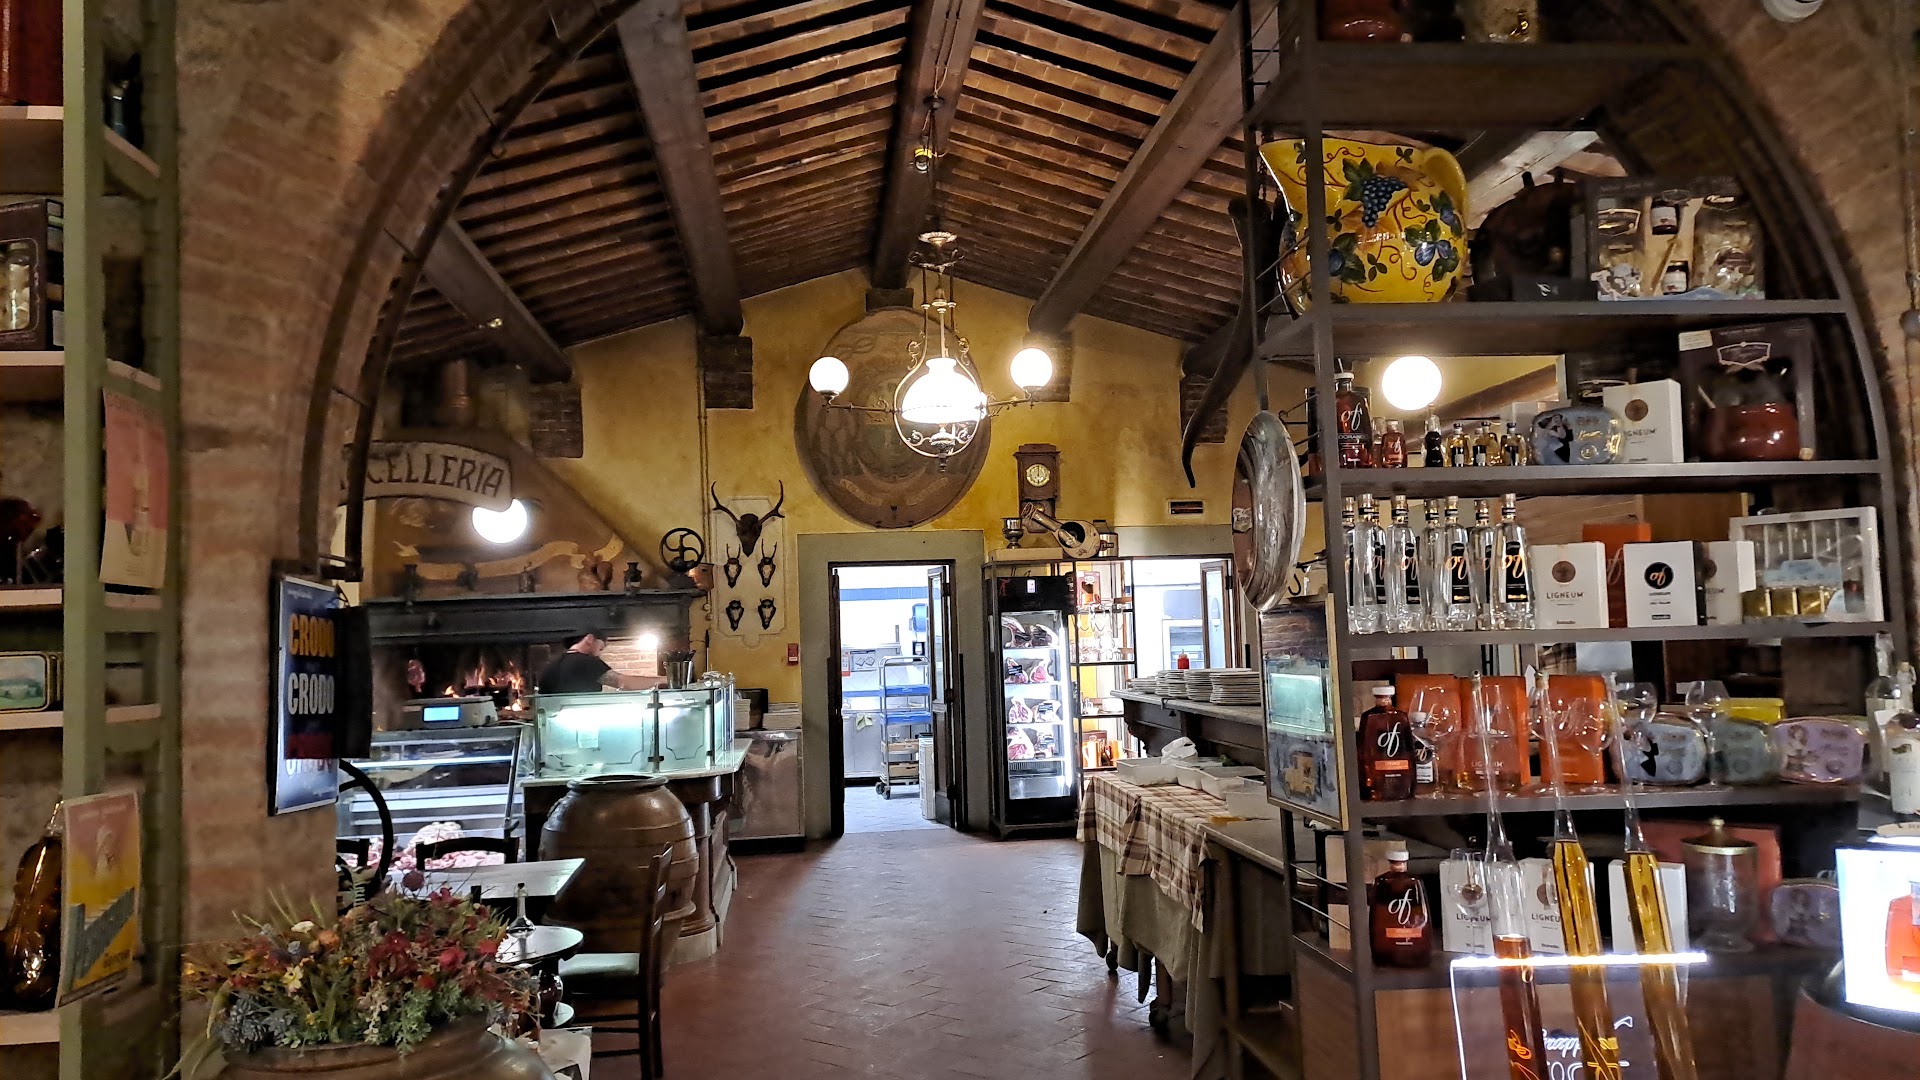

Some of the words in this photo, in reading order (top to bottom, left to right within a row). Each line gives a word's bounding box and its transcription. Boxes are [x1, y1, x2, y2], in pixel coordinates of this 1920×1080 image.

[1623, 428, 1657, 437] IGNEUM
[340, 451, 505, 497] CELLERIA
[1649, 566, 1668, 586] of
[1546, 591, 1585, 599] LIGNEUM
[289, 612, 336, 658] CRODO
[287, 672, 336, 715] CRODO
[1377, 721, 1401, 758] of
[1388, 888, 1413, 925] of
[1531, 912, 1561, 923] LIGNEU
